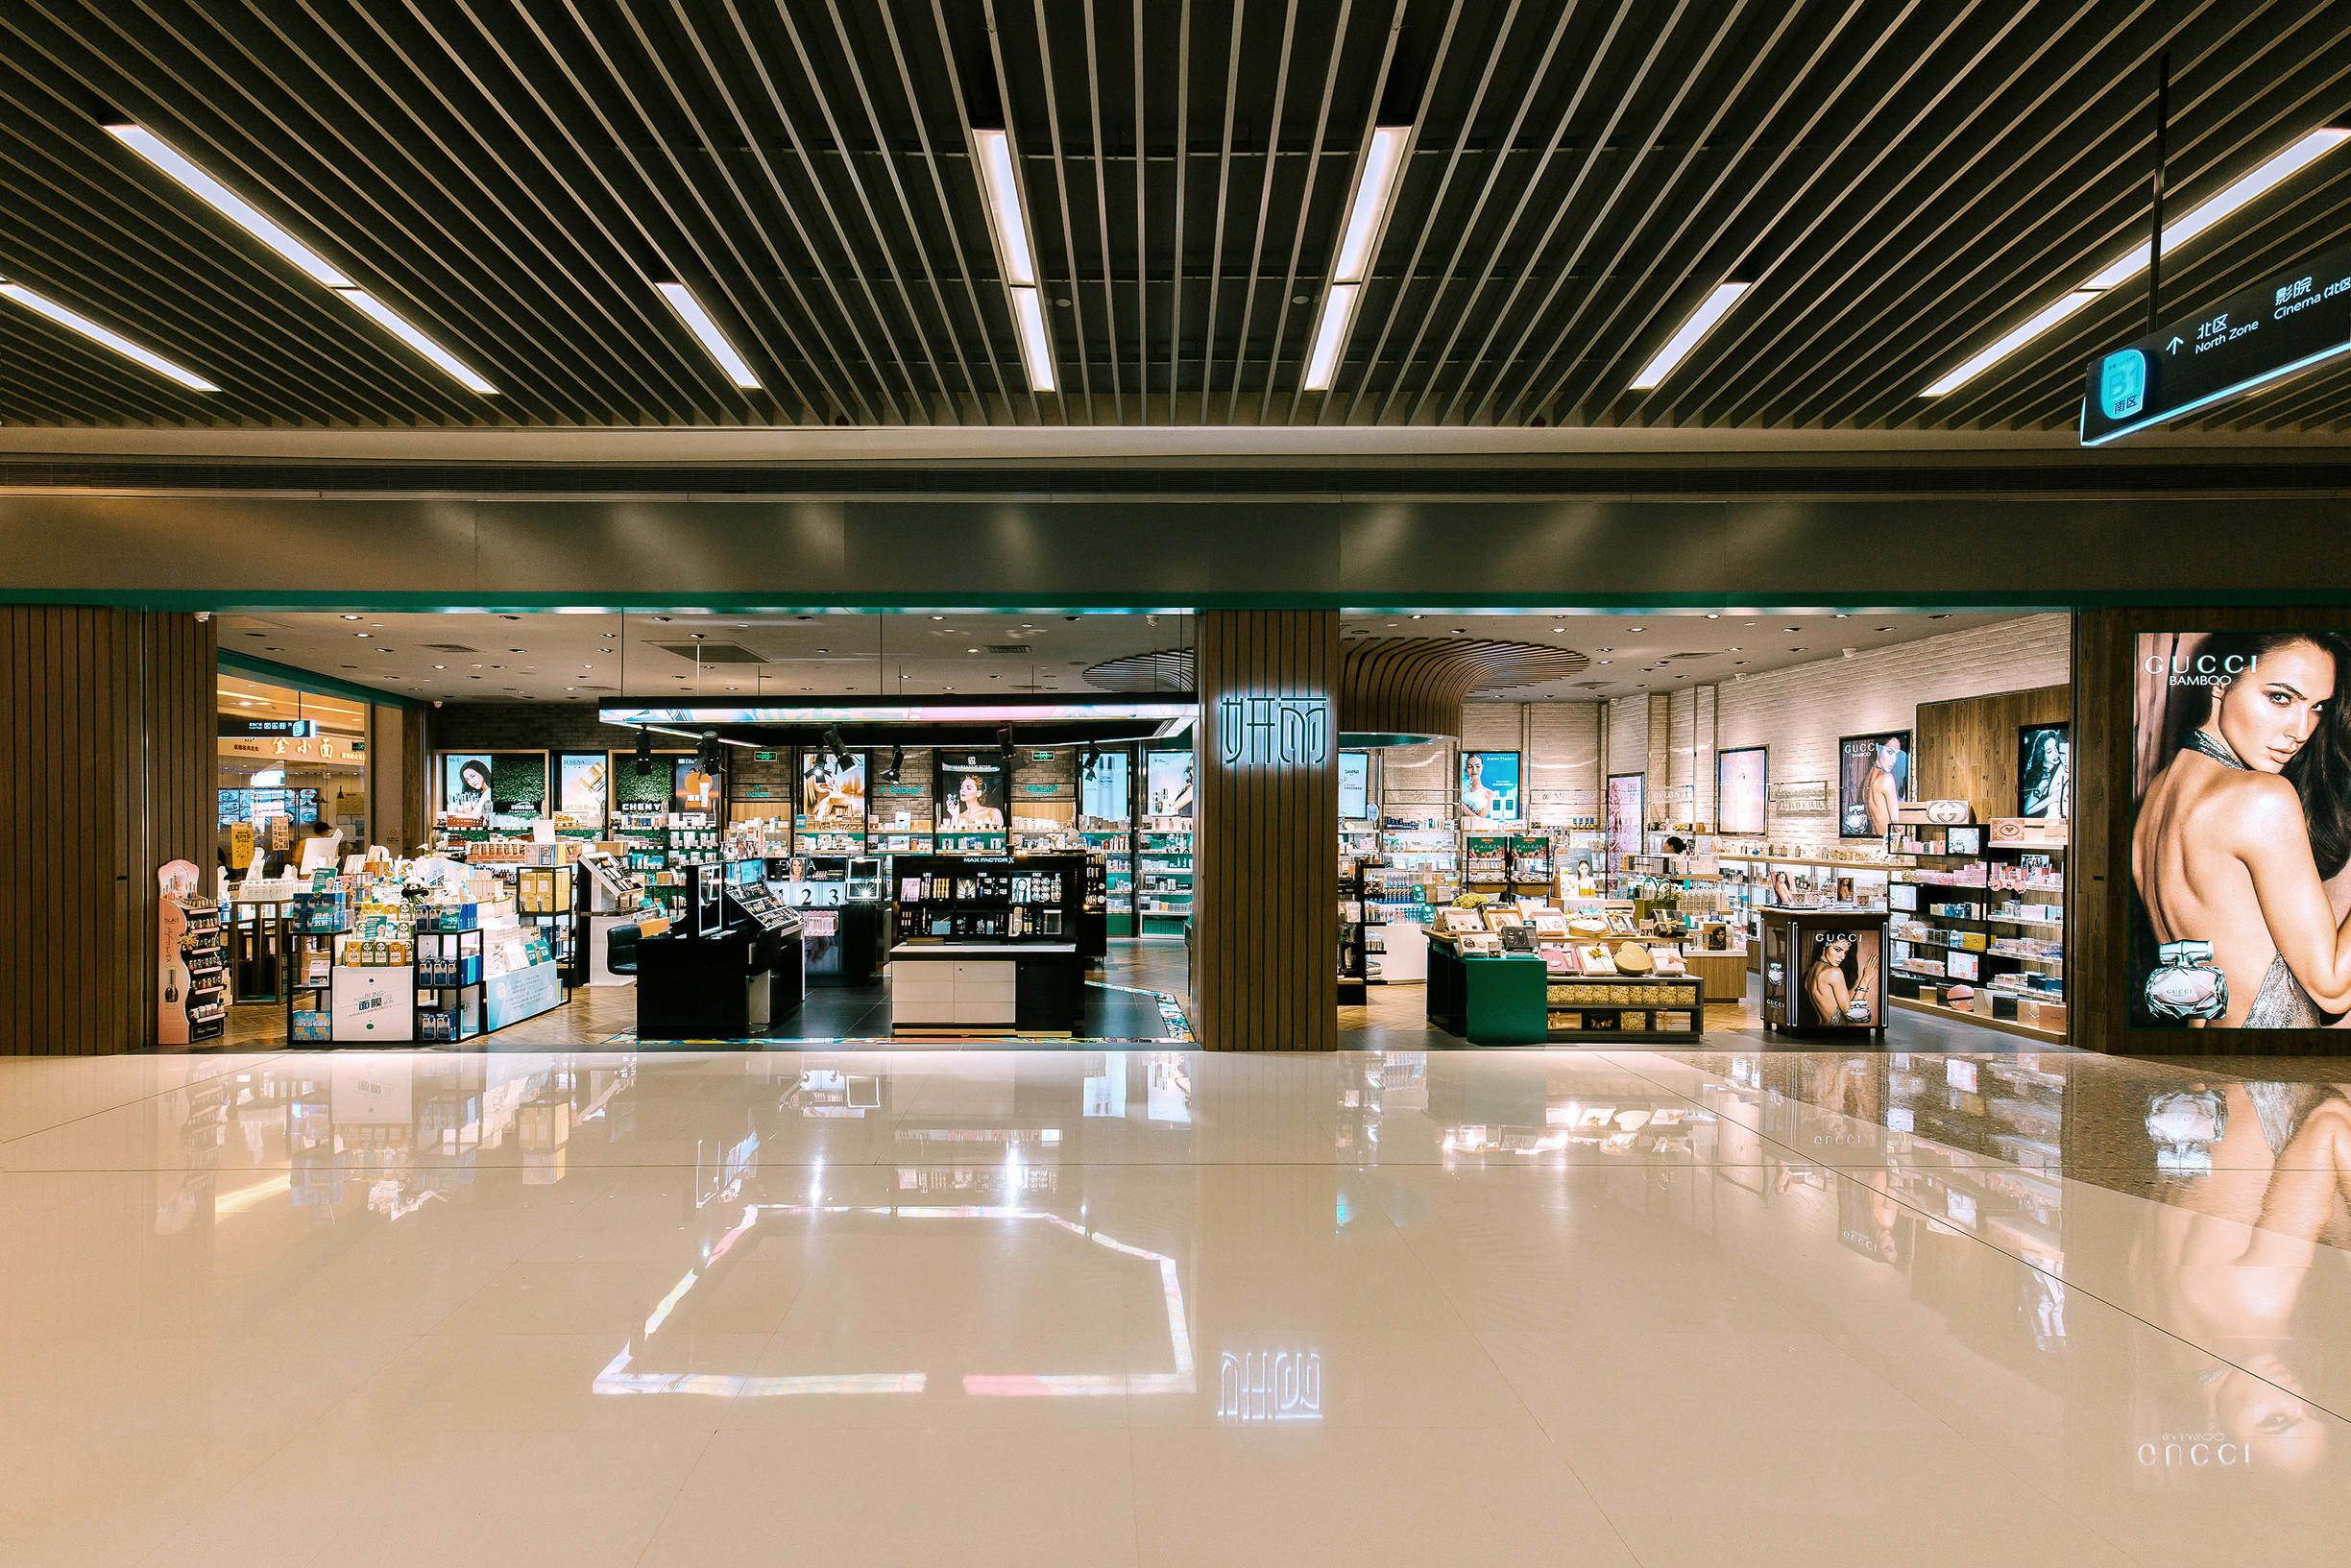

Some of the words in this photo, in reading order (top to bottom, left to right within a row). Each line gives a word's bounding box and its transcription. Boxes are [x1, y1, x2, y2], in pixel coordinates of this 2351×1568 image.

[2274, 276, 2313, 306] 影院
[2273, 293, 2321, 320] Cinema
[2196, 313, 2228, 340] 北区
[2195, 333, 2226, 354] North
[2228, 320, 2259, 340] Zone
[2114, 395, 2137, 415] 南区
[2144, 654, 2257, 675] GUCCI
[2169, 675, 2232, 686] BAMBOO
[1844, 742, 1879, 754] GUCCI
[801, 888, 812, 905] 2
[828, 888, 839, 905] 3
[1815, 933, 1863, 942] GUCCI
[1766, 999, 1785, 1008] GUCCI
